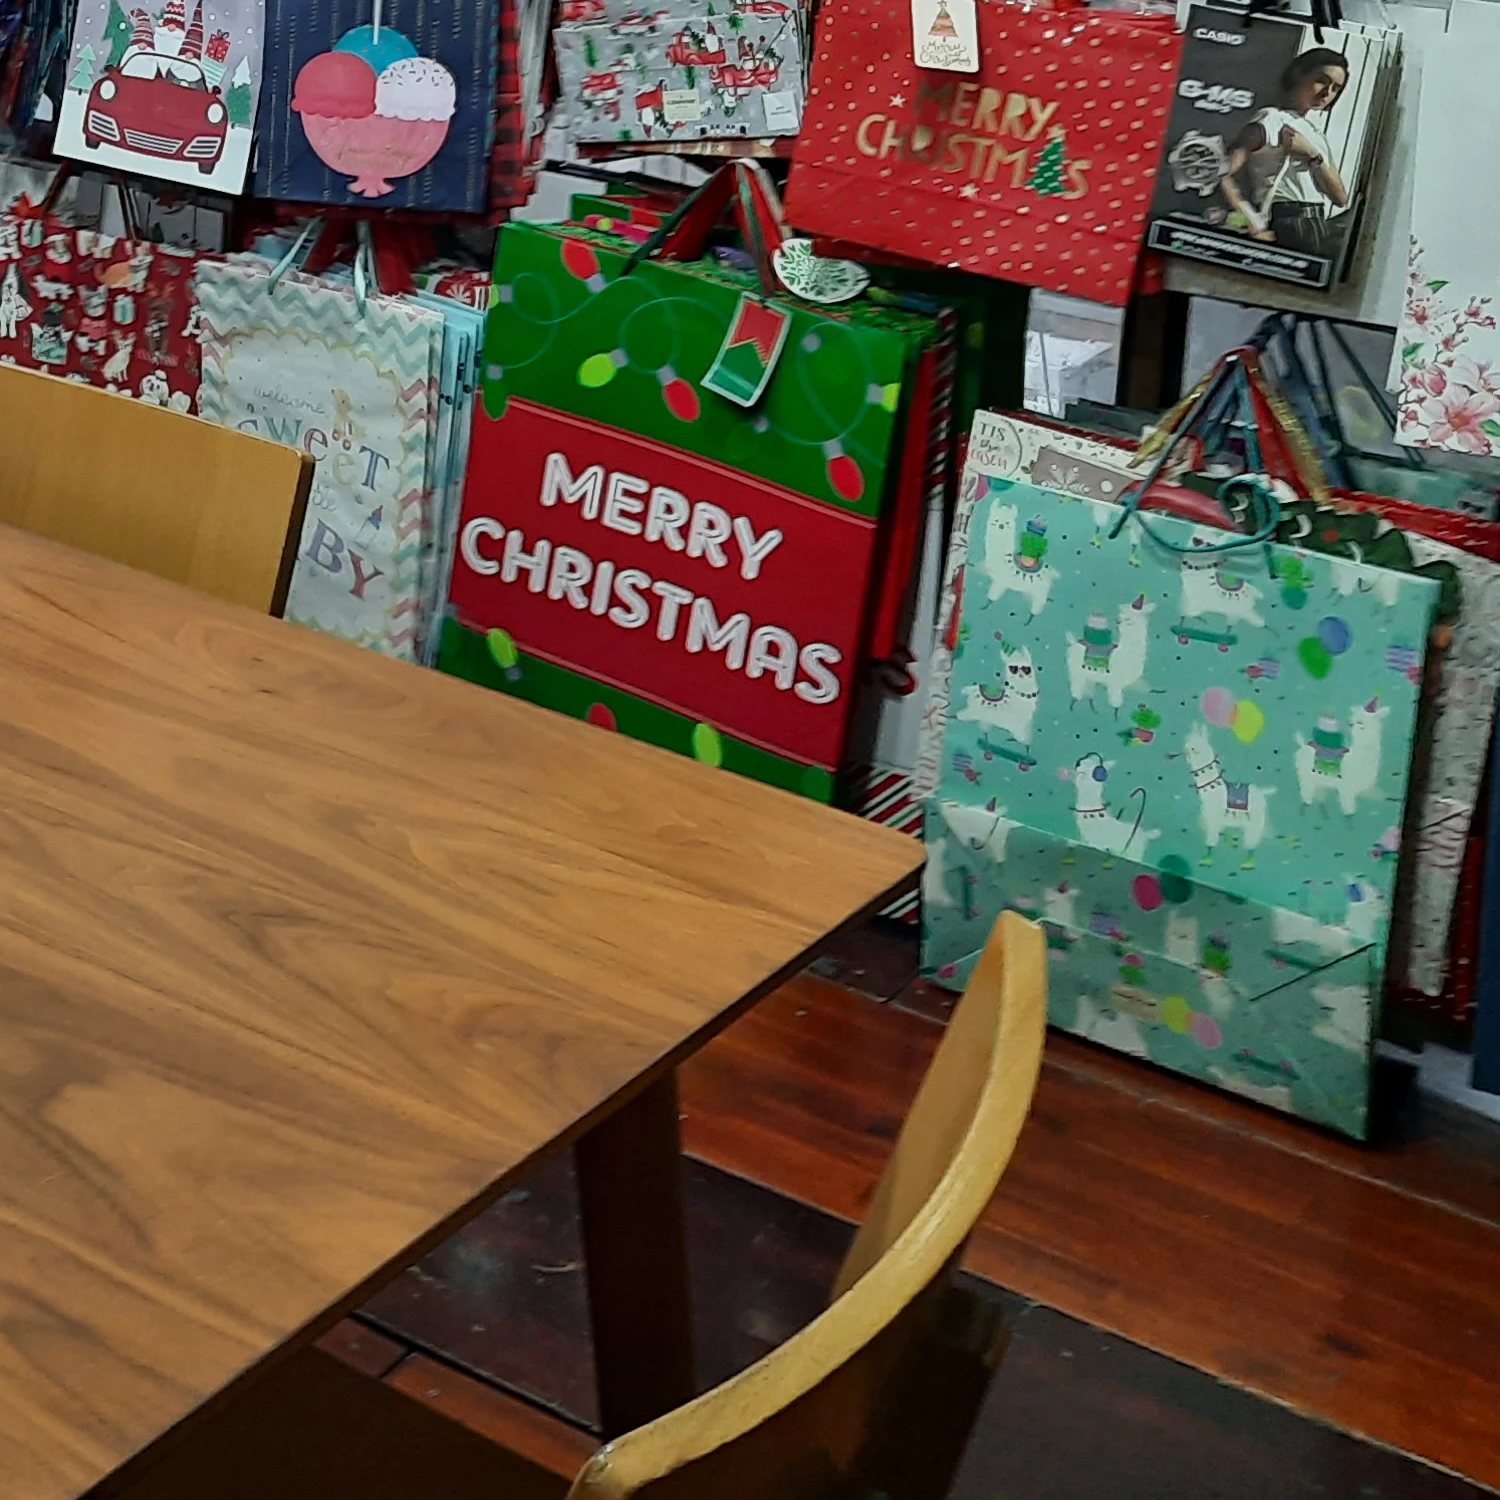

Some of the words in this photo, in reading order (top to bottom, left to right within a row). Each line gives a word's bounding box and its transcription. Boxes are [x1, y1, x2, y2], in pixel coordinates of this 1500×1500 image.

[1194, 28, 1246, 46] CASIO
[911, 80, 1061, 142] MERRY
[254, 385, 326, 414] welcome
[540, 452, 784, 580] MERRY
[460, 515, 843, 705] CHRISTMAS
